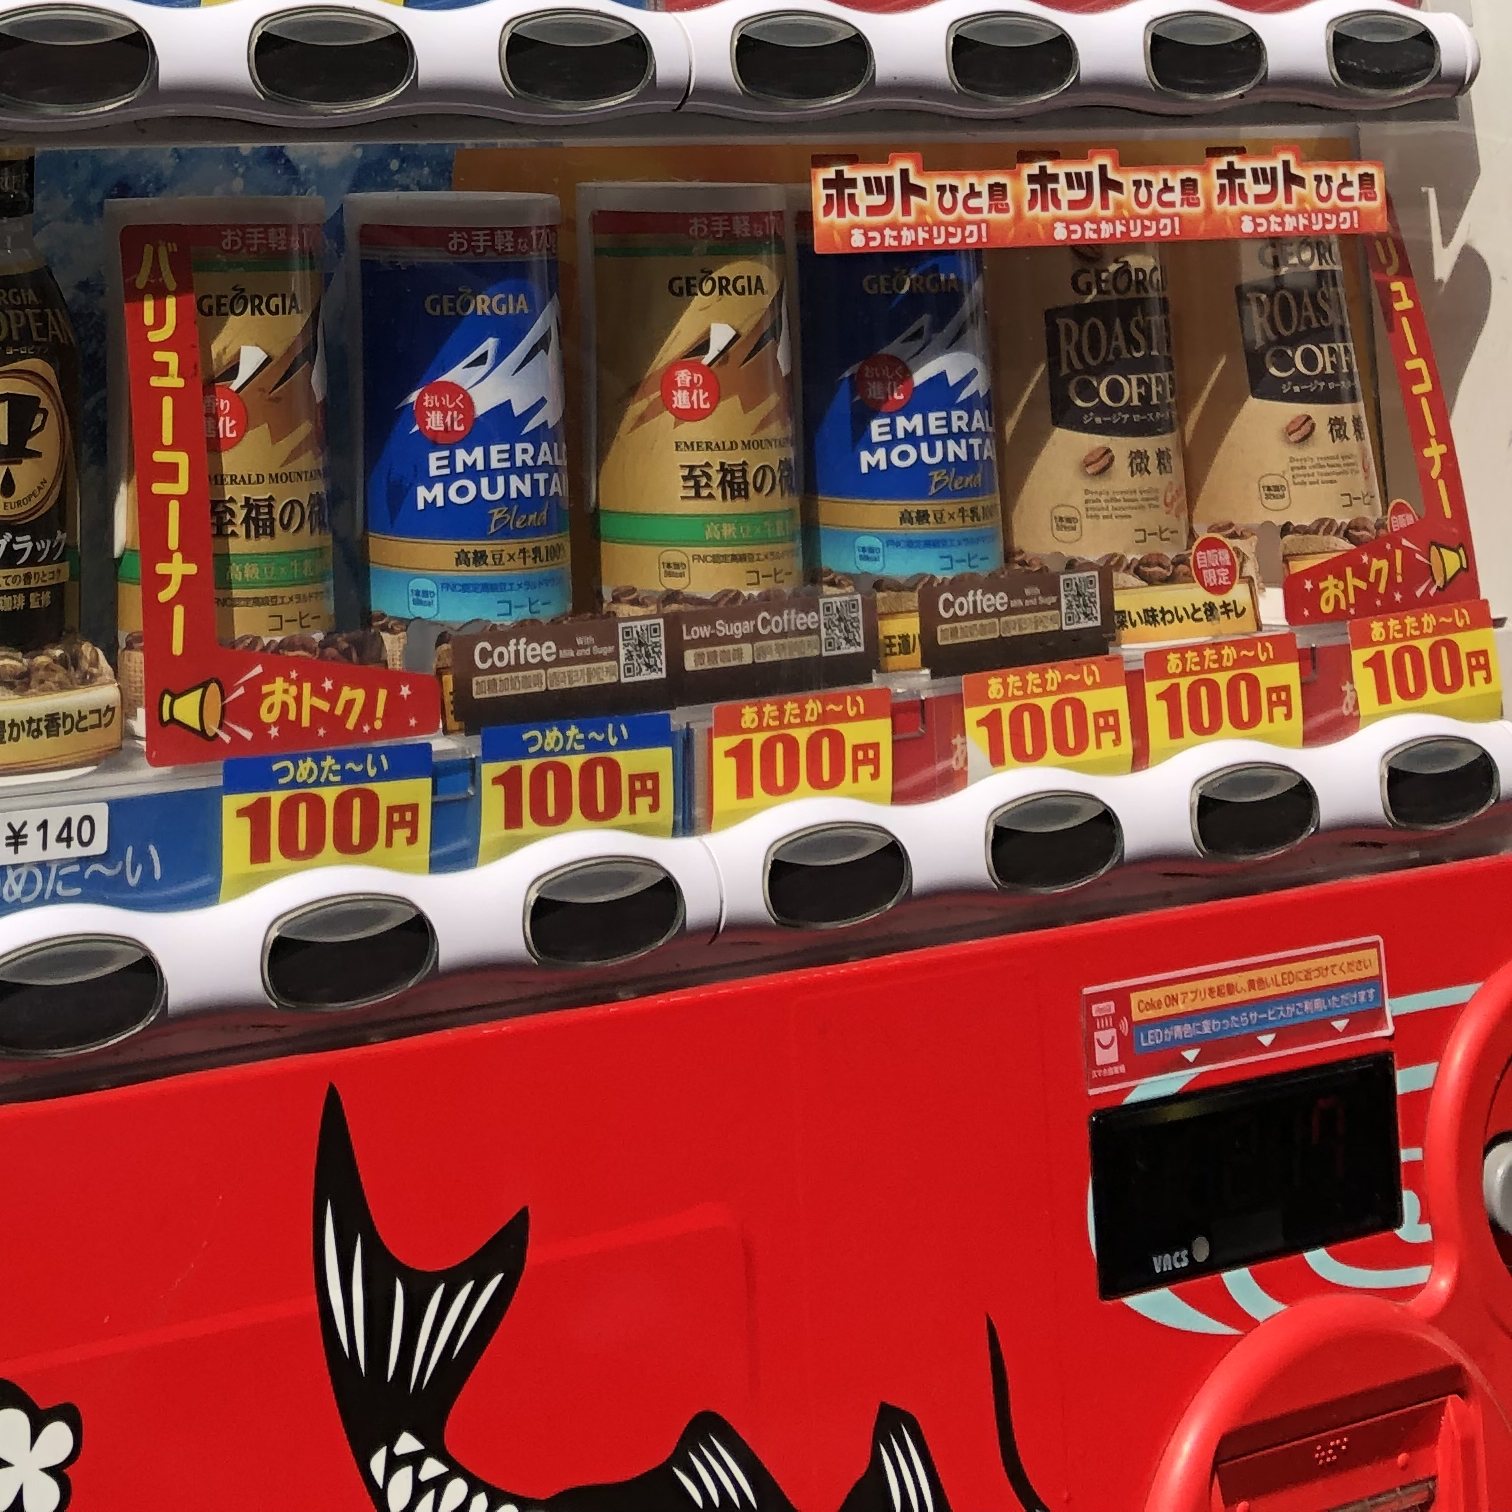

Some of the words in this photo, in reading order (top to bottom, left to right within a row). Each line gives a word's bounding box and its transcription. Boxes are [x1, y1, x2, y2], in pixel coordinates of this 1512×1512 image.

[668, 269, 766, 297] GEORGIA
[198, 284, 301, 317] GEORGIA
[424, 287, 529, 317] GEORGIA
[673, 371, 704, 388] 香り
[422, 392, 465, 410] おいしく
[671, 390, 711, 411] 進化
[425, 410, 465, 432] 進化
[136, 241, 198, 657] バリューコーナー
[674, 438, 738, 453] EMERALD
[4, 478, 48, 510] EUROPEAN
[929, 468, 983, 497] Blend
[488, 506, 548, 535] Blend
[1202, 566, 1232, 589] 限定
[1318, 548, 1404, 615] おトク!
[938, 587, 1009, 619] Coffee
[268, 610, 321, 633] コーヒー
[682, 619, 755, 640] Low-Sugar
[757, 610, 819, 635] Coffee
[474, 638, 557, 669] Coffee
[1362, 637, 1493, 706] 100円
[260, 674, 387, 732] おトク!
[1155, 670, 1293, 741] 100円
[976, 696, 1123, 769] 100円
[723, 726, 882, 801] 100円
[491, 756, 661, 831] 100円
[4, 814, 97, 854] ¥140
[236, 788, 421, 867] 100円
